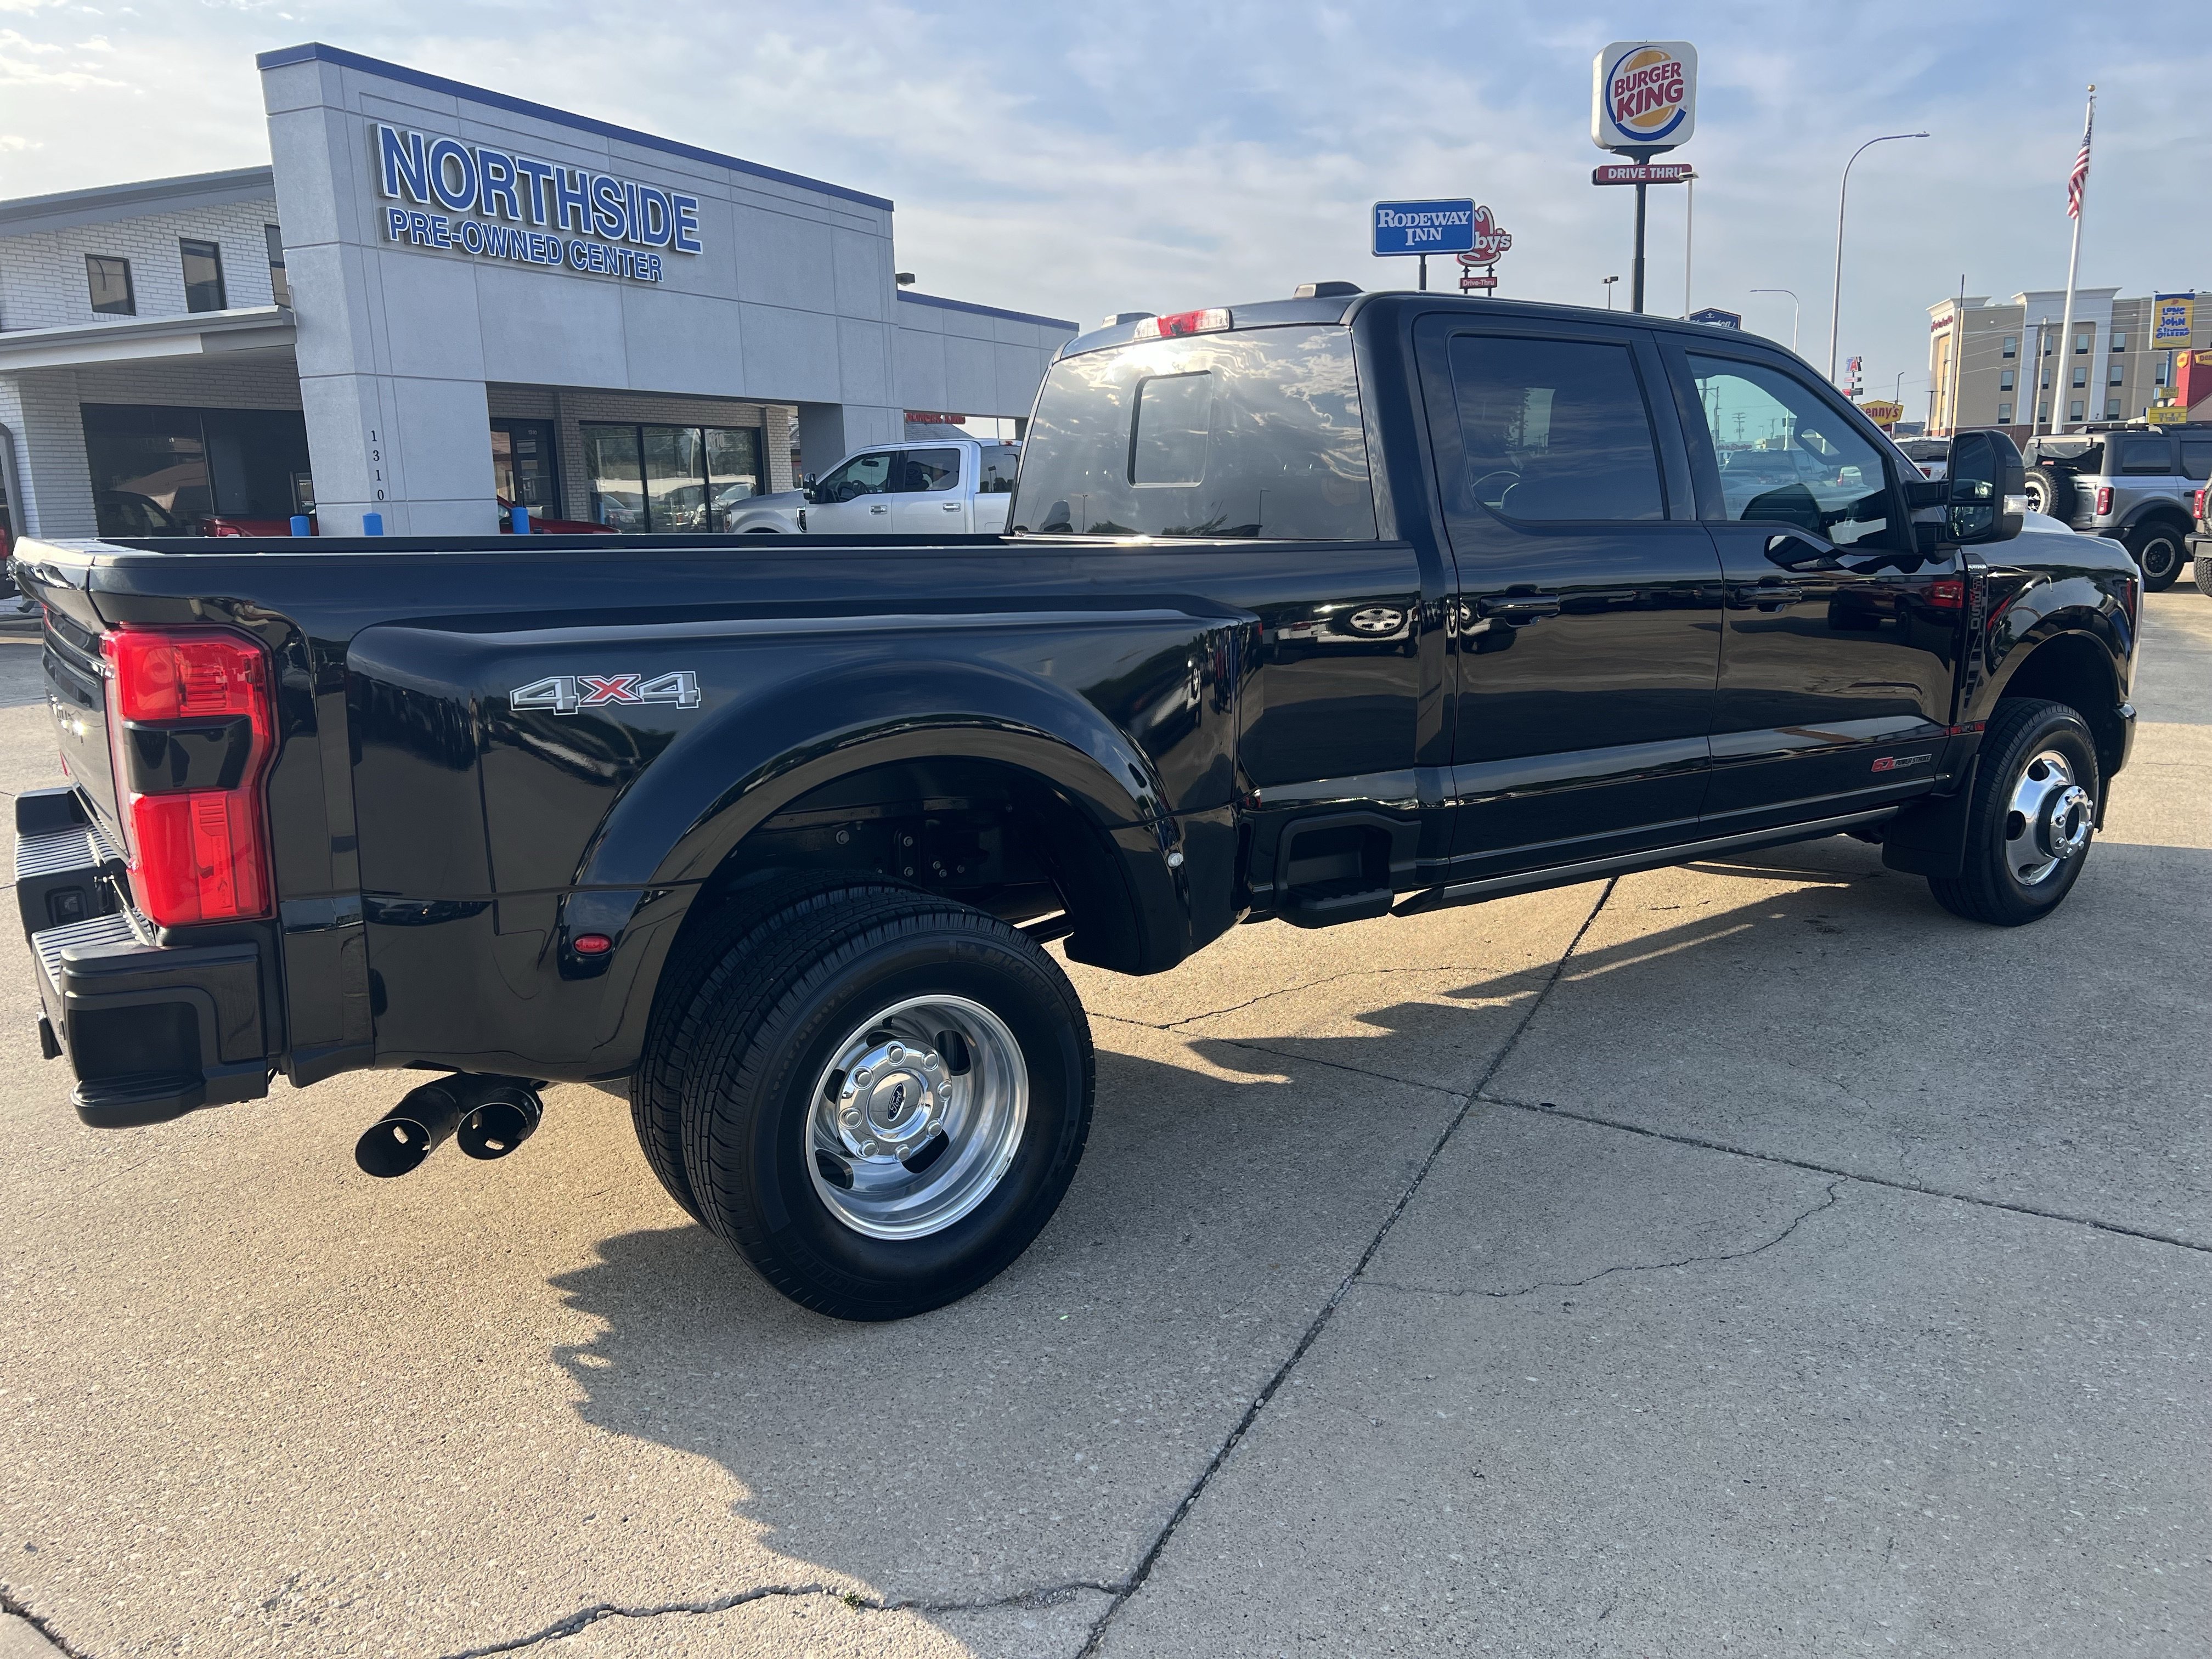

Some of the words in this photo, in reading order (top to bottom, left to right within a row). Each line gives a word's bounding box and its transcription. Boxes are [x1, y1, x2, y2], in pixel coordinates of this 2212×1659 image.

[1615, 62, 1681, 98] BURGER
[1617, 79, 1684, 123] KING
[1608, 168, 1645, 179] DRIVE
[1650, 167, 1683, 178] THRU
[376, 123, 703, 255] NORTHSIDE
[1378, 210, 1470, 228] RODEWAY
[386, 207, 564, 266] PRE-OWNED
[566, 240, 663, 282] CENTER
[1406, 227, 1442, 246] INN
[1474, 228, 1512, 253] by's
[890, 1090, 902, 1113] Ford
